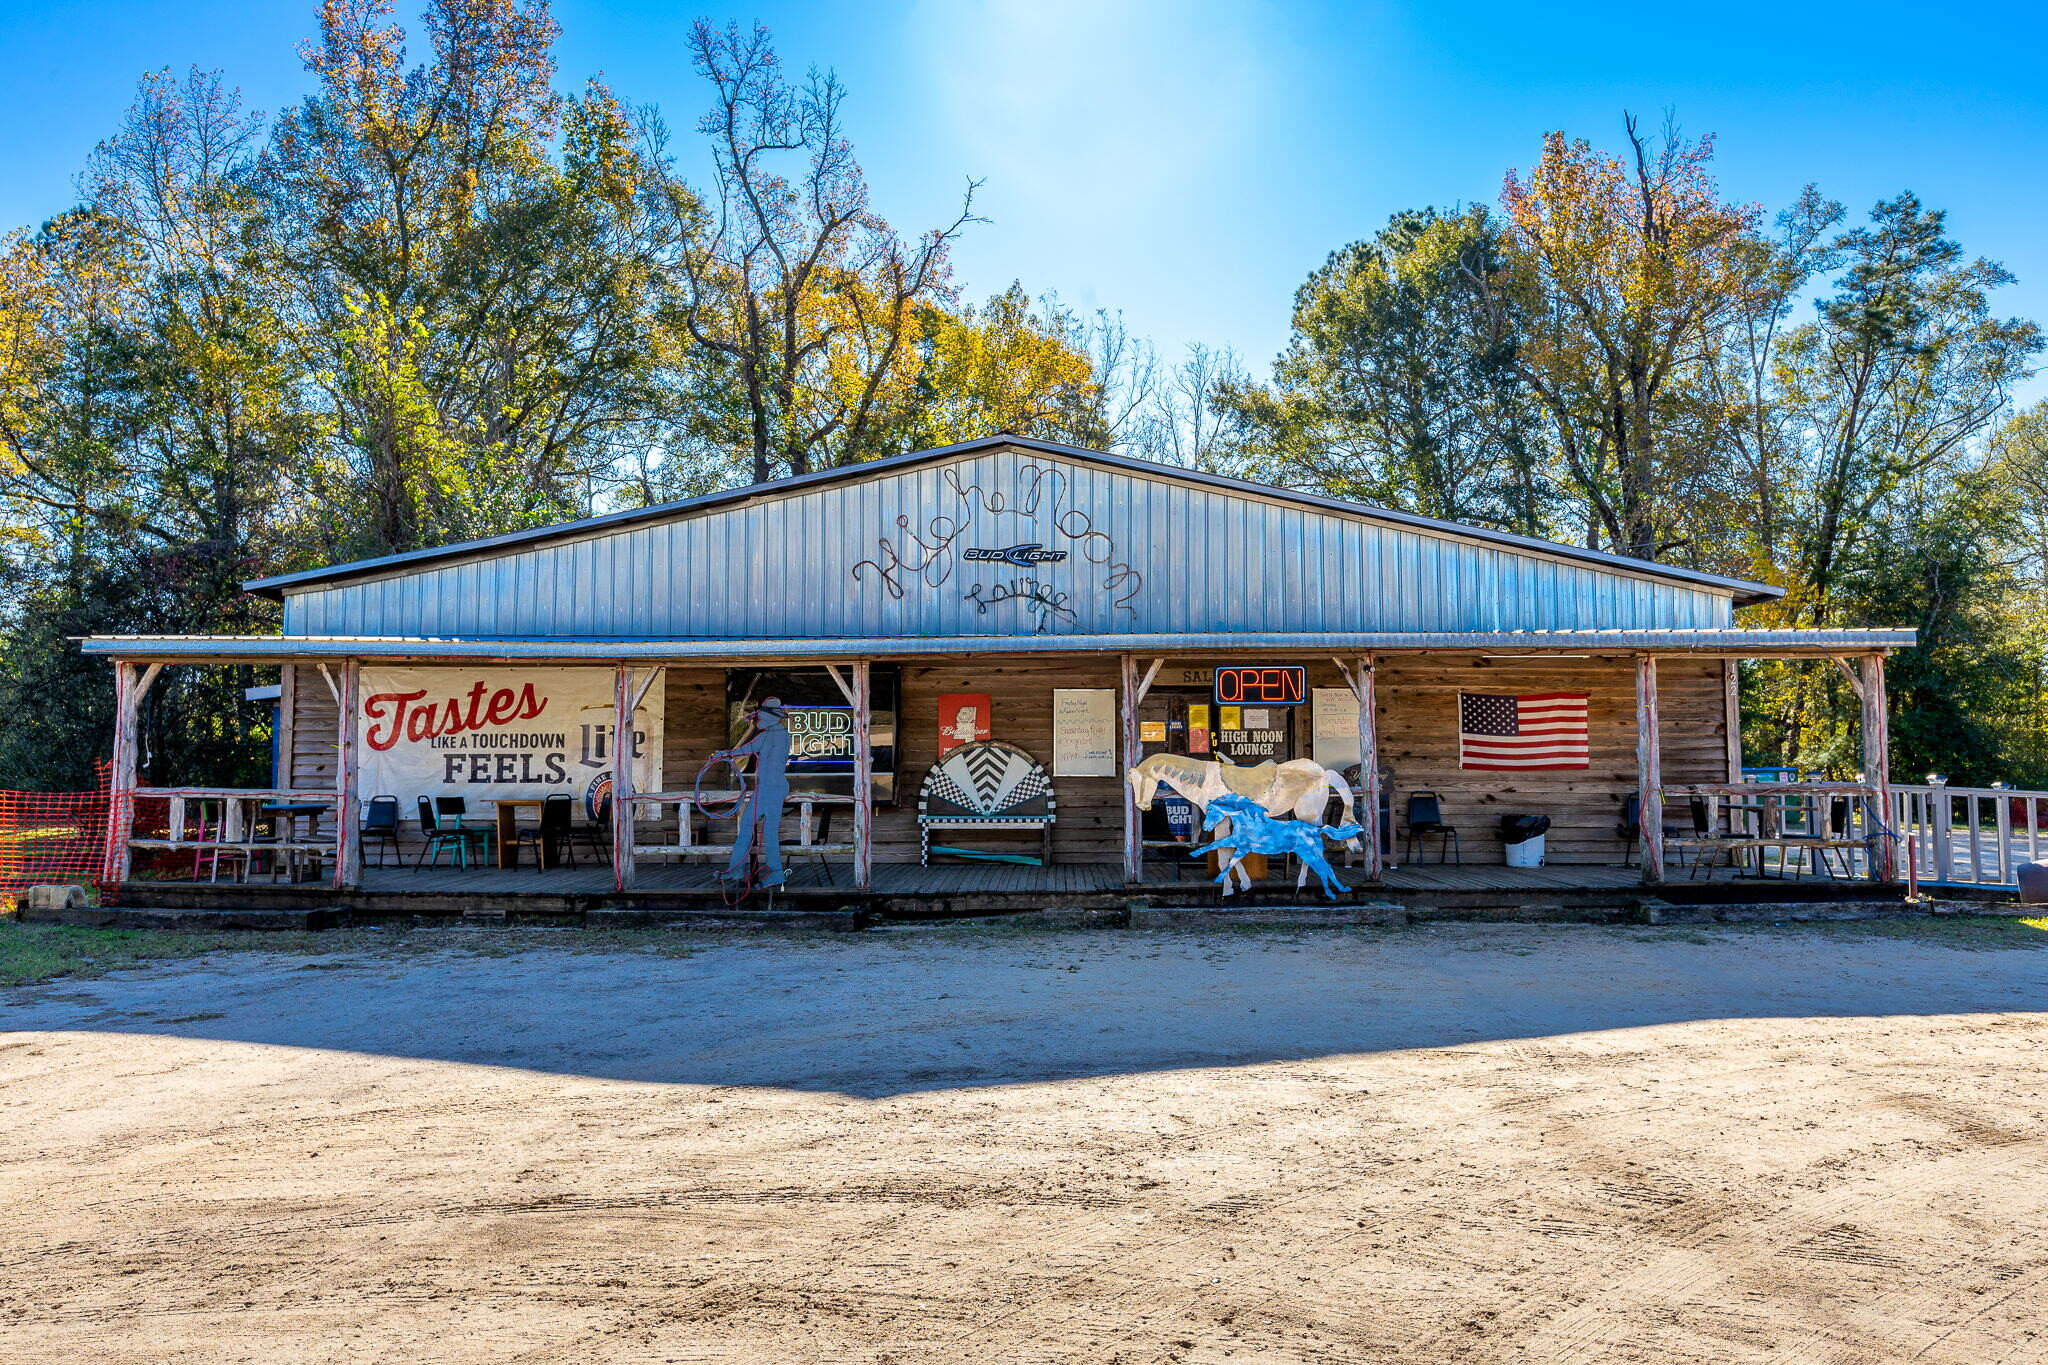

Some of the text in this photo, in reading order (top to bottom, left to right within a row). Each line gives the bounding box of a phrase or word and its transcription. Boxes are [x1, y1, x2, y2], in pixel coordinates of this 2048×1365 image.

[965, 550, 1067, 561] BUD LIGHT
[1183, 671, 1213, 683] SAL
[1219, 669, 1302, 702] OPEN
[364, 680, 549, 751] Tastes
[787, 711, 851, 733] BUD
[431, 733, 566, 749] LIKE A TOUCHDOWN
[1220, 730, 1248, 743] HIGH
[1252, 730, 1284, 743] NOON
[787, 733, 855, 756] IGHT
[1230, 743, 1274, 756] LOUNGE
[442, 752, 573, 785] FEELS.
[1166, 805, 1190, 815] BUD
[1167, 814, 1192, 824] IGHT
